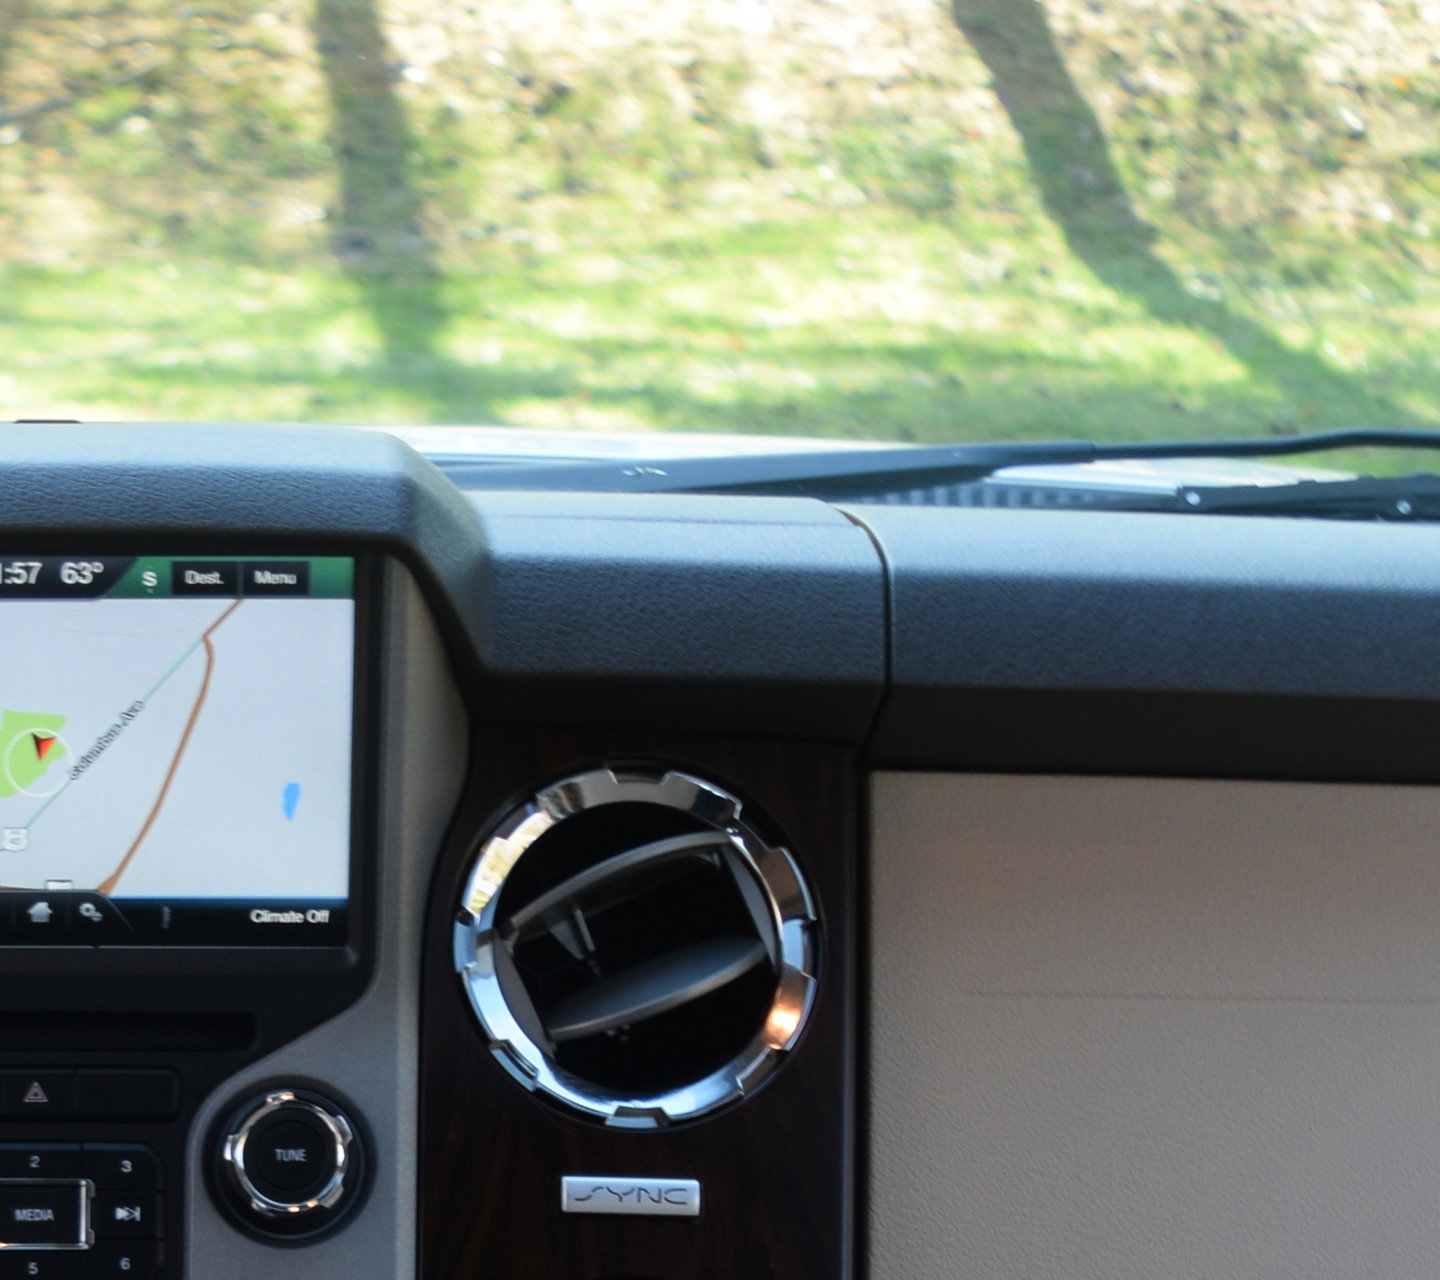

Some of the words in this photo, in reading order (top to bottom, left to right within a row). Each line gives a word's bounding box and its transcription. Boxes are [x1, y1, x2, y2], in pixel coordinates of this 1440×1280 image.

[141, 571, 158, 588] S
[253, 570, 298, 585] Menu
[250, 908, 305, 923] Climate
[306, 908, 331, 923] Off
[29, 1155, 41, 1169] 2
[273, 1148, 308, 1163] TUNE
[120, 1159, 133, 1173] 3
[573, 1185, 689, 1206] SYNC
[14, 1208, 55, 1223] MEDIA
[28, 1261, 40, 1275] 5
[119, 1256, 132, 1271] 6
